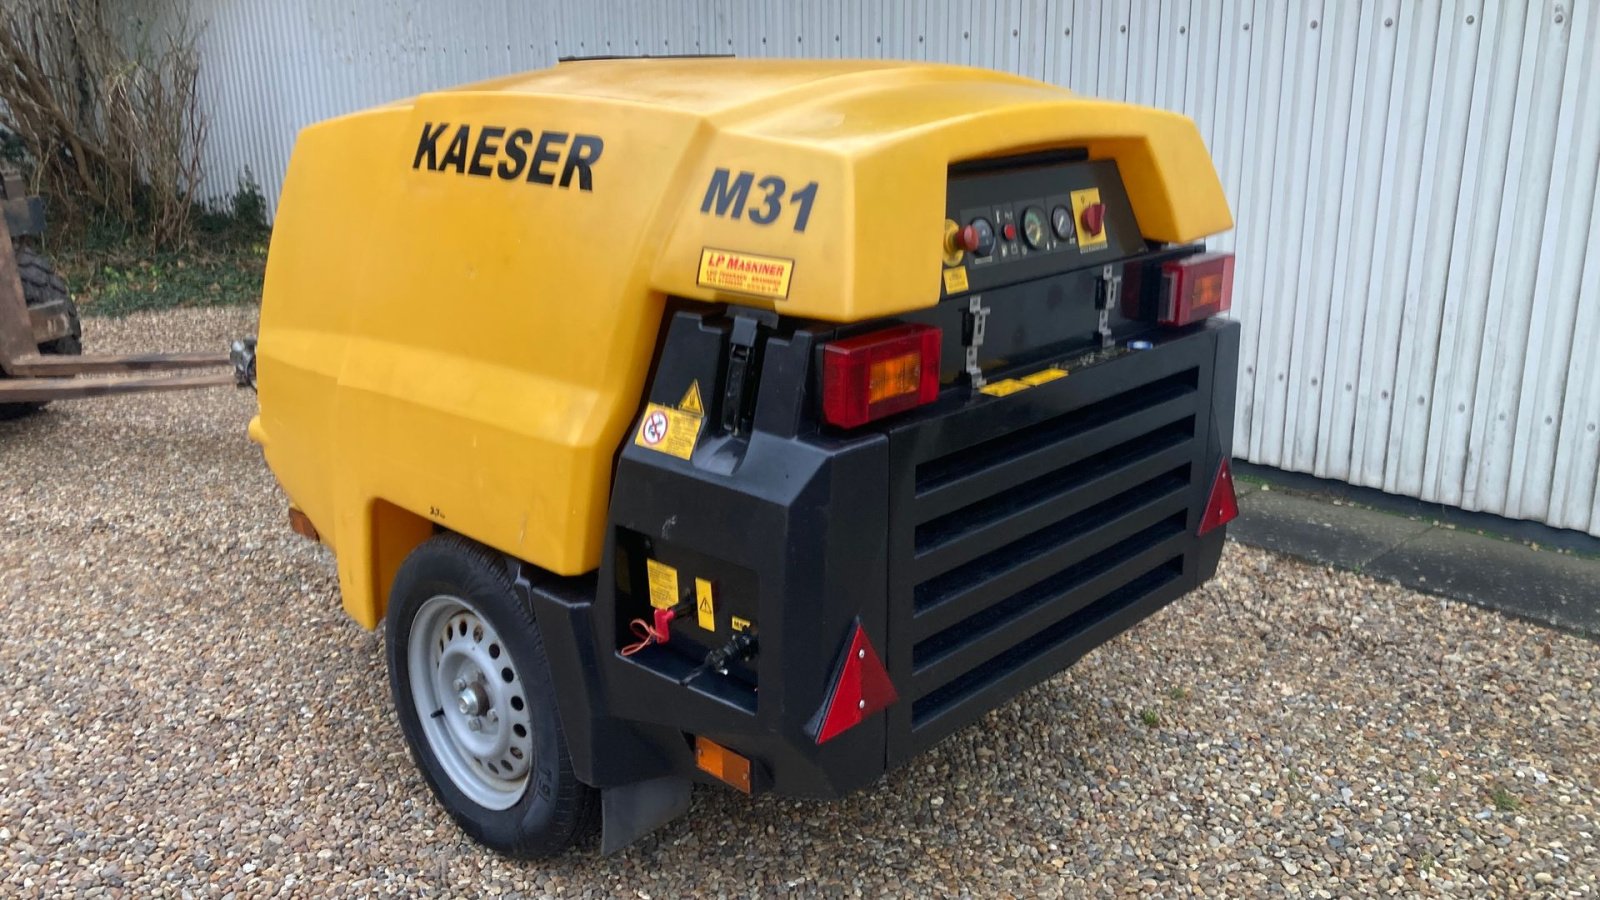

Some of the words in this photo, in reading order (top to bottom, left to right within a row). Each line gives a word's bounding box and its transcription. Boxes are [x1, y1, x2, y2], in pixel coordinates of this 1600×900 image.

[413, 122, 604, 192] KAESER
[700, 167, 818, 233] M31
[708, 255, 725, 267] LP
